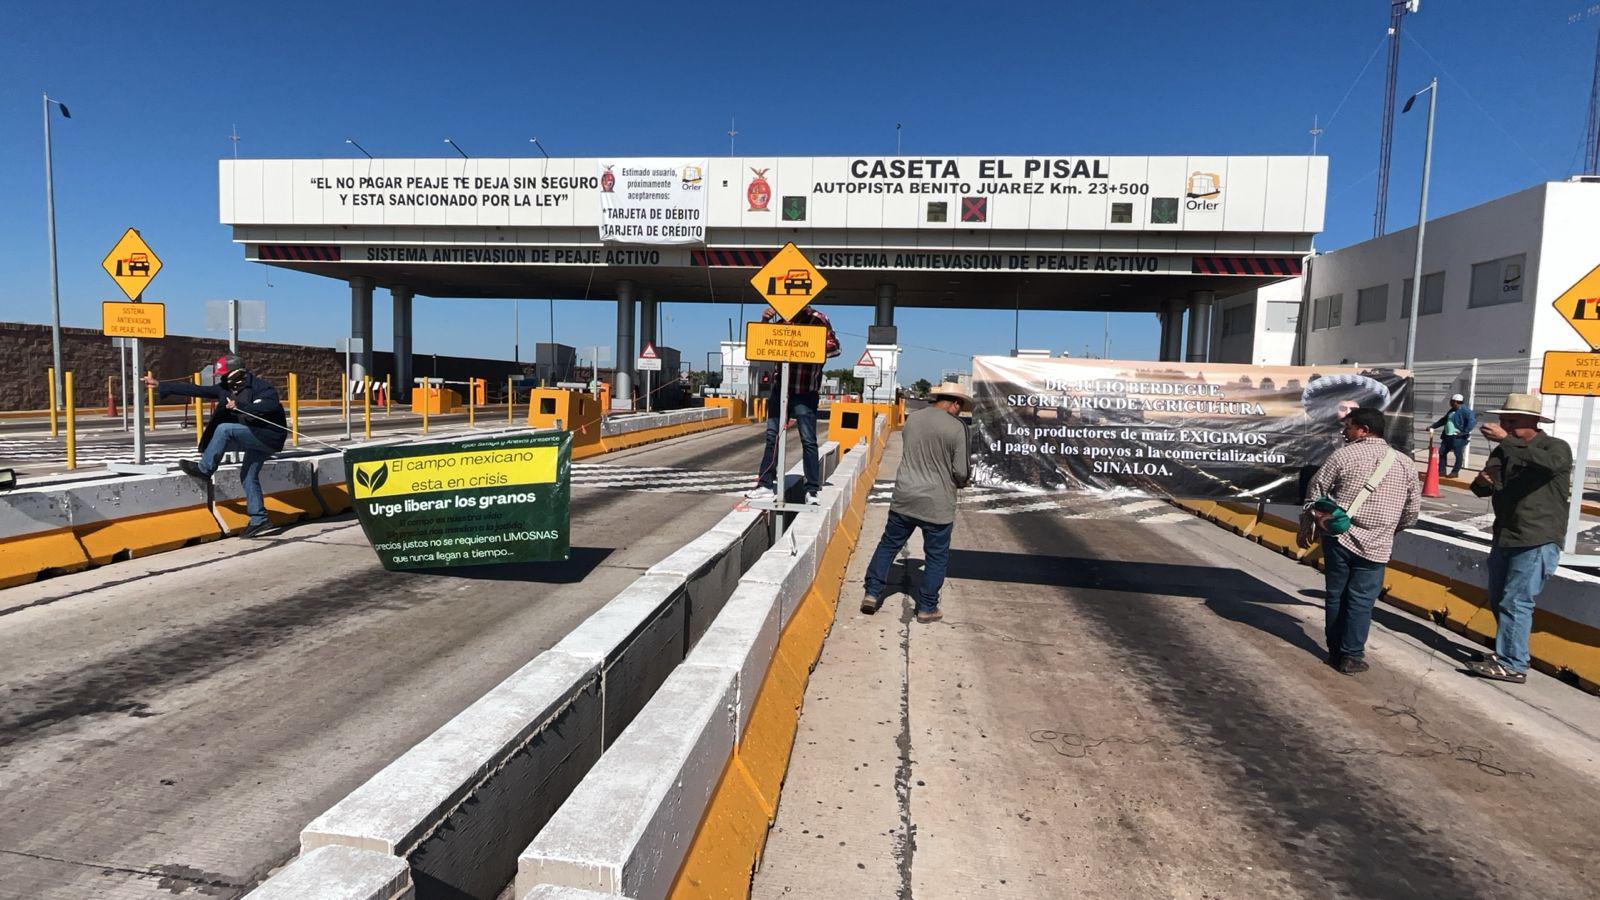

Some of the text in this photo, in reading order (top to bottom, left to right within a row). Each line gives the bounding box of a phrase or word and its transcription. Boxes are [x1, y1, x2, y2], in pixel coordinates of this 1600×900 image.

[622, 168, 678, 178] Estimado usuario,
[851, 159, 1109, 179] CASETA EL PISAL
[310, 177, 598, 189] “EL NO PAGAR PEAJE TE DEJA SIN SEGURO
[627, 179, 671, 189] próximamente
[682, 183, 702, 191] Orler
[813, 182, 1149, 195] AUTOPISTA BENITO JUAREZ Km. 23+500
[340, 194, 568, 207] Y ESTA SANCIONADO POR LA LEY”
[627, 192, 670, 201] aceptaremos:
[1186, 200, 1219, 211] Orler
[650, 208, 662, 220] DE
[665, 206, 700, 220] DÉBITO
[647, 225, 658, 236] DE
[662, 223, 703, 237] CRÉDITO
[367, 247, 660, 265] SISTEMA ANTIEVASION DE PEAJE ACTIVO
[818, 253, 1158, 272] SISTEMA ANTIEVASION DE PEAJE ACTIVO
[117, 316, 151, 324] ANTIEVASION
[772, 329, 801, 337] SISTEMA
[764, 339, 809, 348] ANTIEVASION
[756, 348, 816, 358] DE PEAJE ACTIVO
[1576, 358, 1600, 366] SISTE
[1565, 369, 1600, 378] ANTIEVA
[1045, 380, 1071, 392] DR.
[1074, 380, 1125, 393] JULIO
[1568, 381, 1594, 390] PEAJE
[1007, 394, 1266, 415] SECRETARIO DE AGRICULTURA
[1007, 423, 1267, 445] Los productores de maíz EXIGIMOS
[990, 440, 1286, 464] el pago de los apoyos a la comercialización
[392, 451, 534, 472] El campo mexicano
[1093, 461, 1173, 477] SINALOA.
[411, 472, 508, 492] esta en crisis
[369, 492, 536, 517] Urge liberar los granos
[375, 542, 402, 550] precios
[402, 540, 428, 551] justos
[443, 538, 453, 546] se
[455, 535, 502, 546] requieren
[503, 530, 558, 542] LIMOSNAS
[392, 555, 408, 564] que
[410, 554, 434, 562] nunca
[436, 551, 460, 561] llegan
